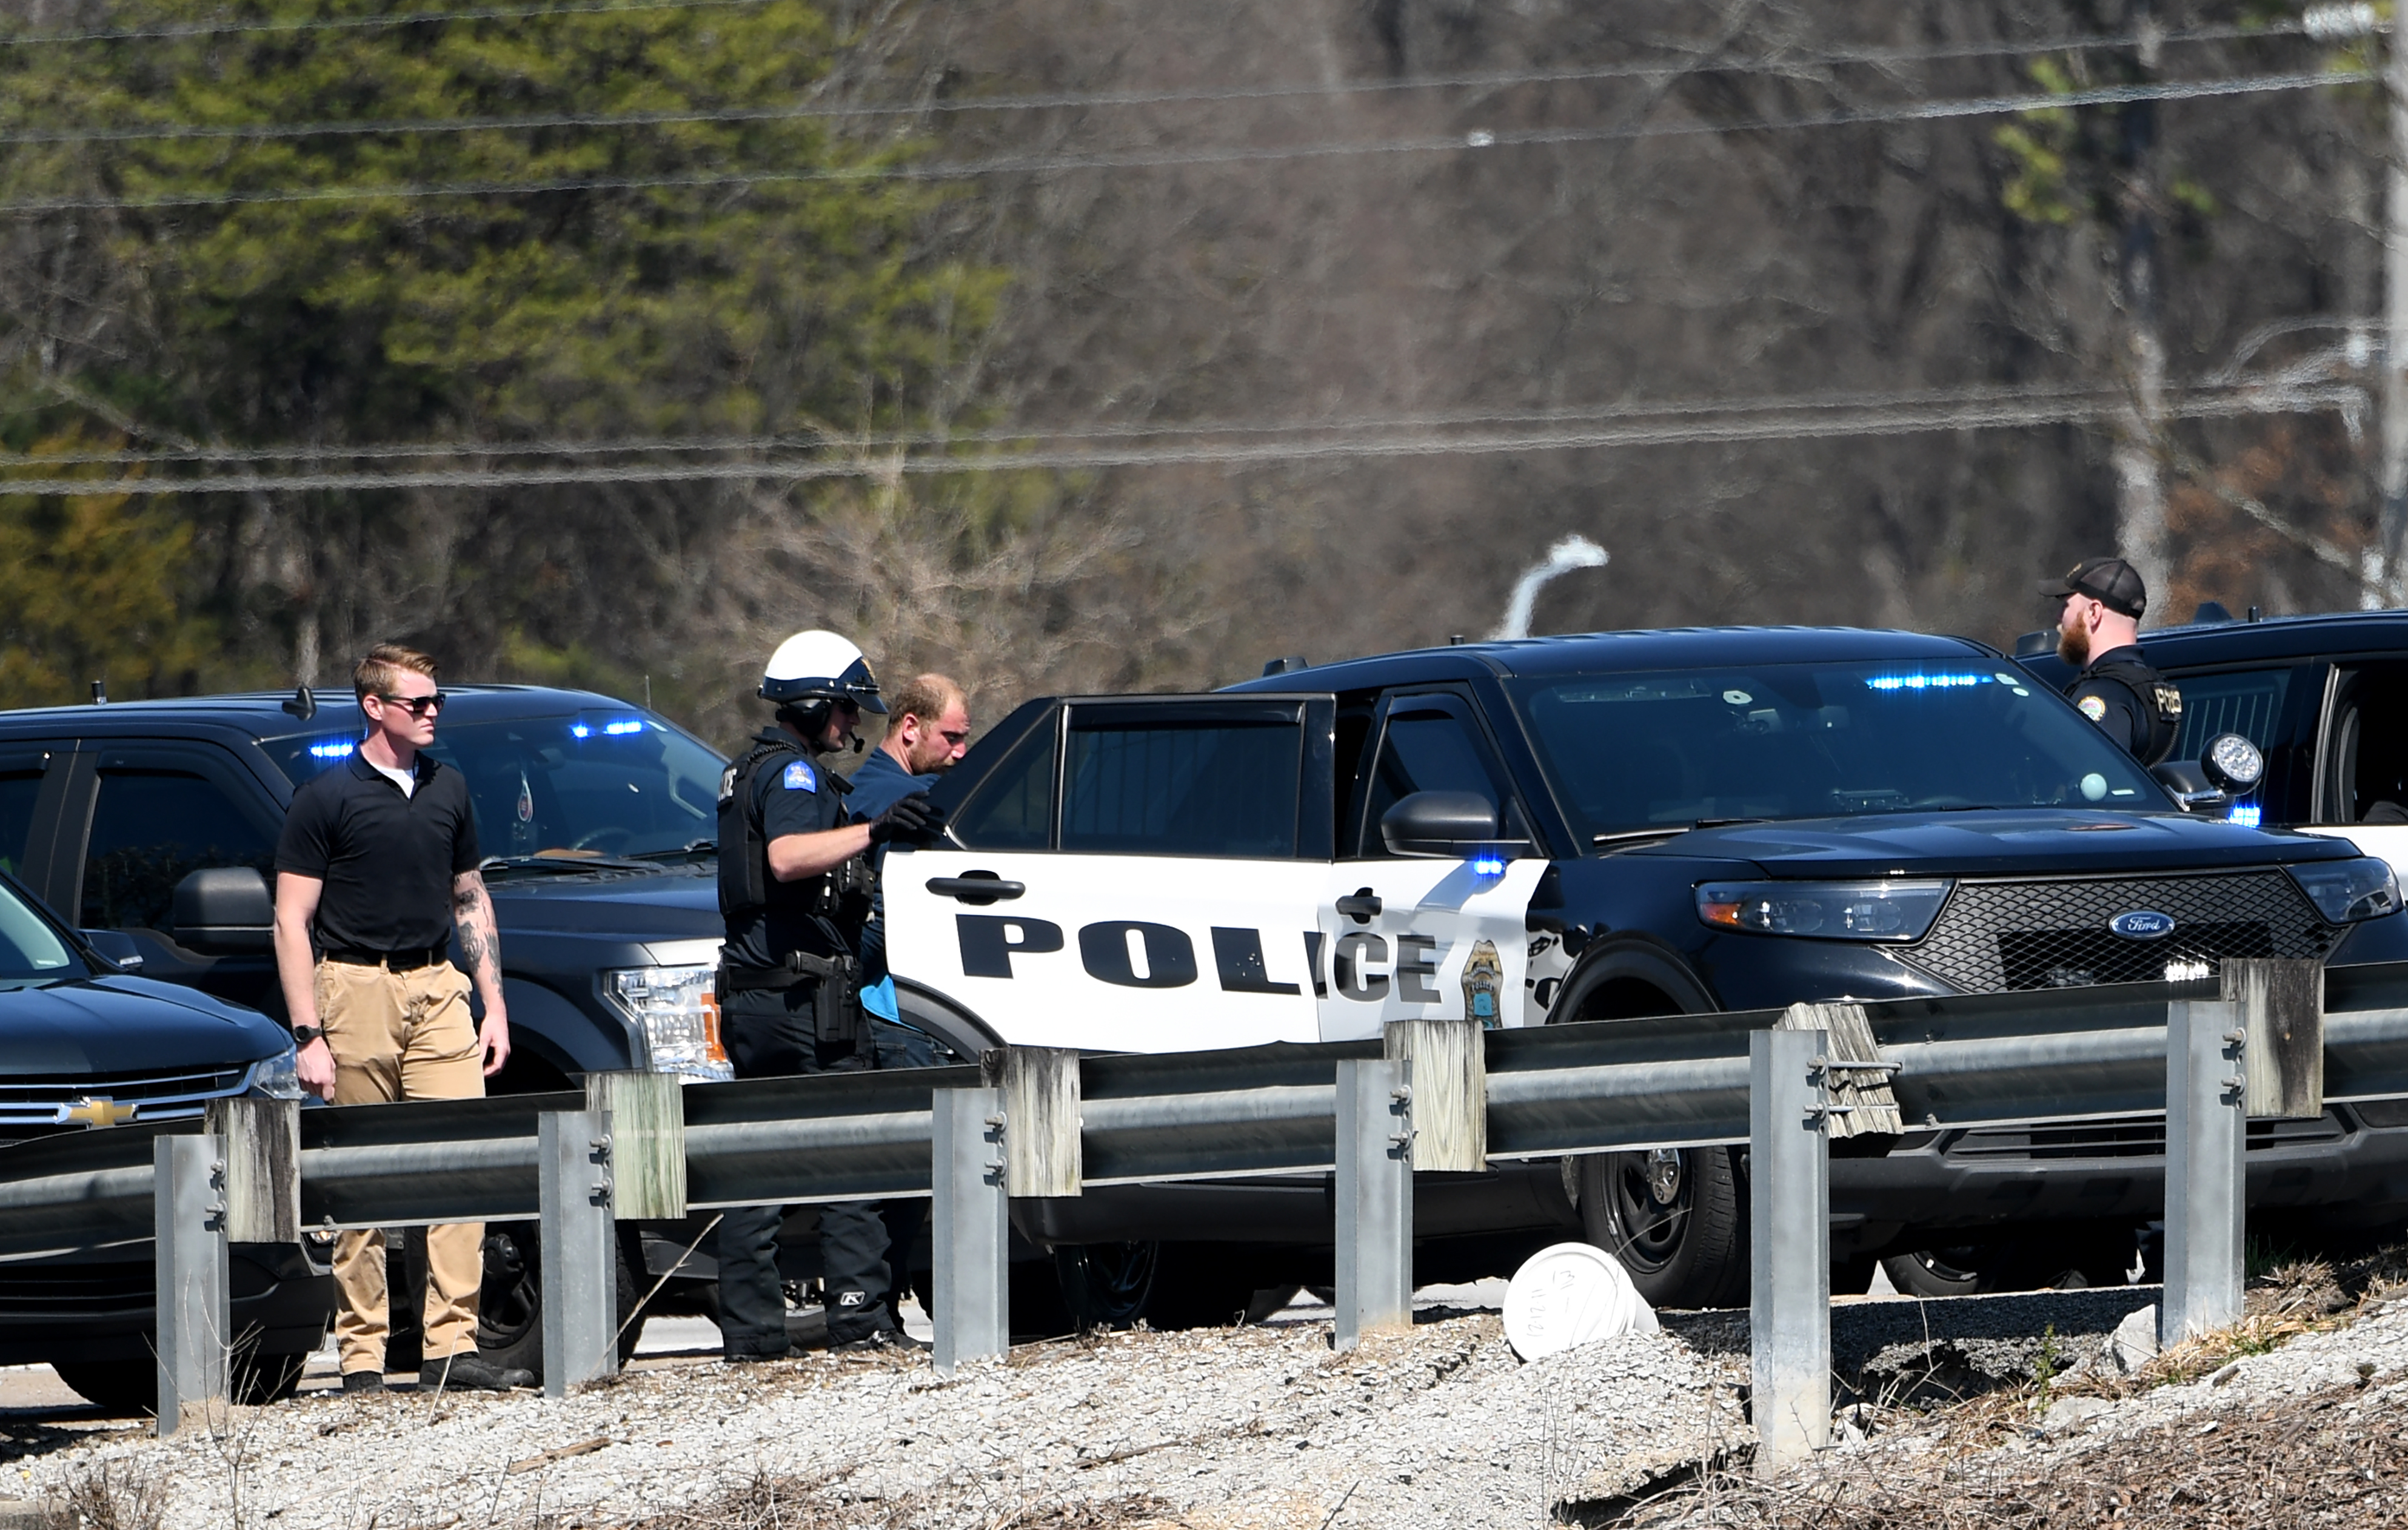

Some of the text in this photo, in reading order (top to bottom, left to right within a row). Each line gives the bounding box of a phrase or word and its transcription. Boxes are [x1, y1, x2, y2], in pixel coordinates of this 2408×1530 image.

[2128, 916, 2161, 931] Ford
[955, 914, 1442, 1004] POLICE
[1471, 981, 1493, 991] POLICE
